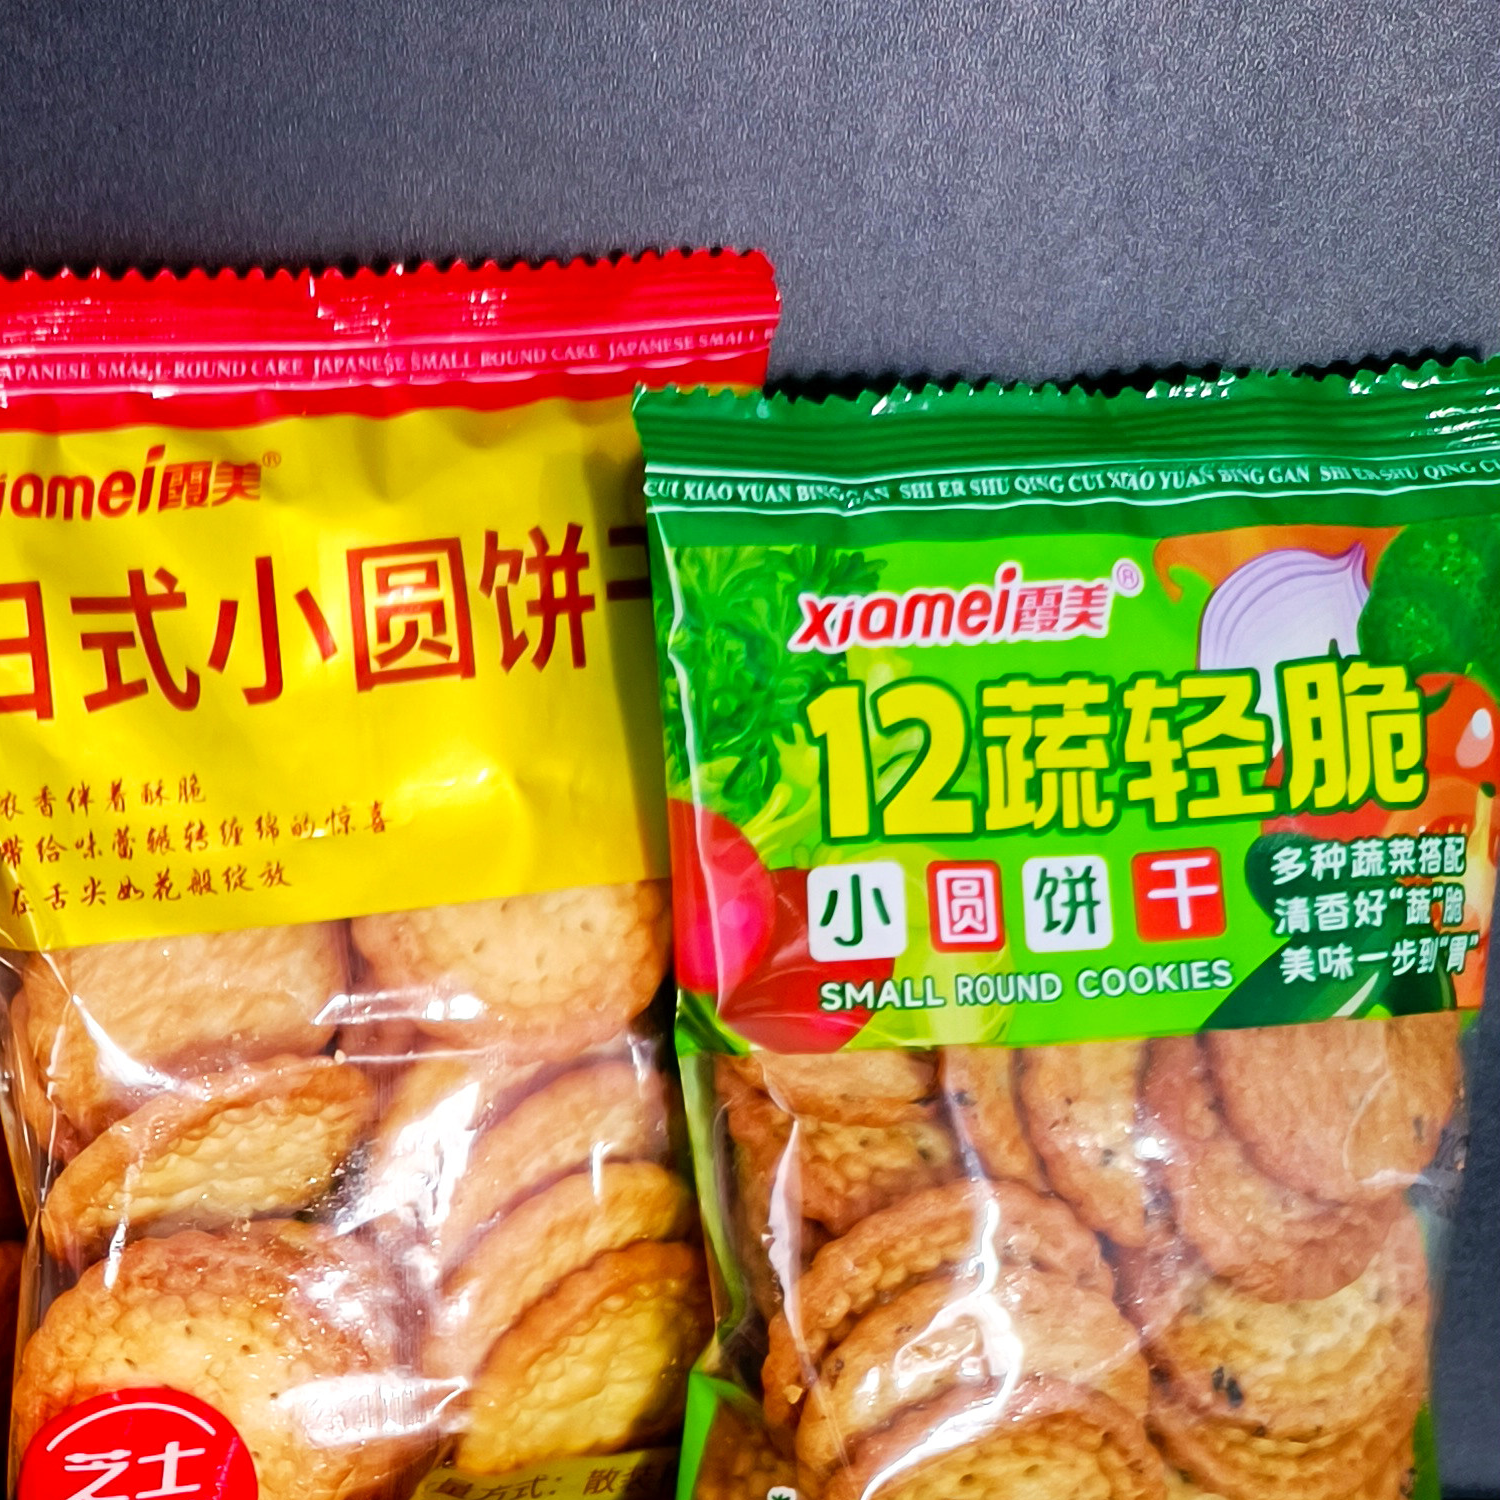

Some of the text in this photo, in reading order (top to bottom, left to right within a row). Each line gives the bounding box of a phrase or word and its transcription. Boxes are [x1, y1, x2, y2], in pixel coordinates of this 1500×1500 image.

[173, 359, 247, 379] ROUND
[251, 357, 304, 377] CAKE
[312, 353, 406, 377] JAPANESE
[410, 350, 477, 372] SMALL
[479, 347, 547, 368] ROUND
[551, 343, 599, 361] CAKE
[608, 334, 695, 359] JAPANESE
[698, 329, 757, 348] SMALL
[643, 478, 680, 499] CUI
[683, 480, 734, 501] XIAO
[736, 483, 792, 503] YUAN
[899, 480, 935, 500] SHI
[937, 479, 967, 498] ER
[969, 476, 1011, 497] SHU
[1013, 474, 1065, 494] QING
[1067, 472, 1107, 493] CUI
[1106, 470, 1155, 491] XIAO
[1158, 465, 1215, 490] YUAN
[1217, 464, 1265, 485] BING
[1267, 465, 1311, 484] GAN
[1318, 464, 1351, 482] SHI
[1422, 460, 1476, 482] QING
[804, 658, 1427, 842] 12蔬轻脆
[1269, 834, 1466, 886] 多种蔬菜搭配
[11, 860, 293, 919] 在舌尖如花般绽放
[819, 958, 1235, 1012] SMALL ROUND COOKIES
